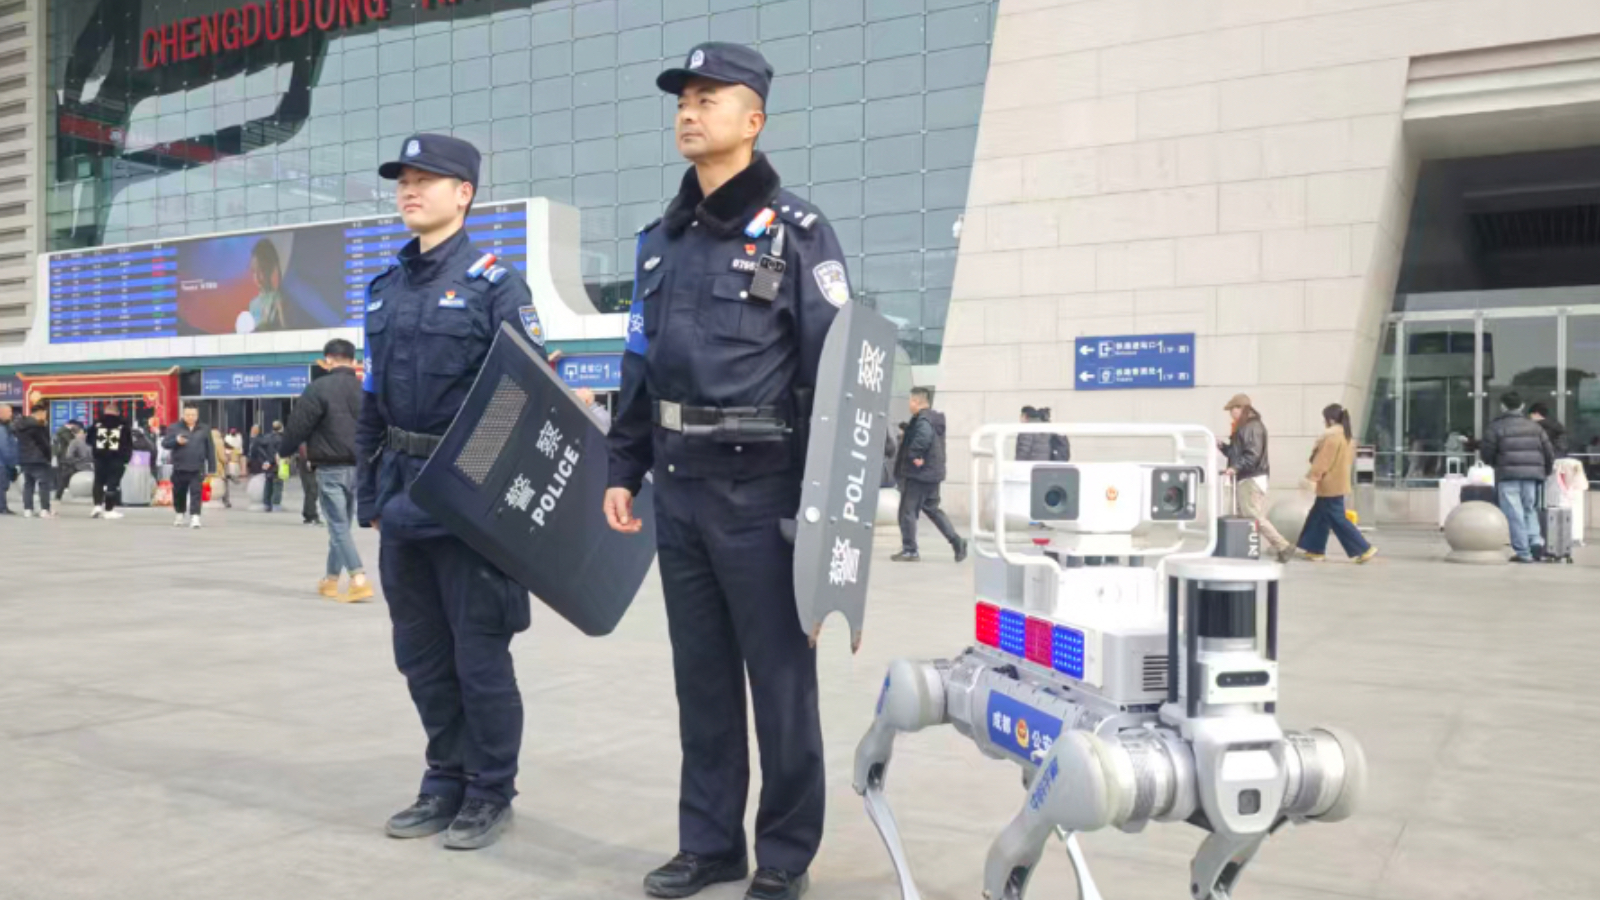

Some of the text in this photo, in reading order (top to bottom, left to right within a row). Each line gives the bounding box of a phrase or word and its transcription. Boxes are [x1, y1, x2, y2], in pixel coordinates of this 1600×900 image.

[141, 0, 386, 68] CHENGDUDONG
[857, 339, 887, 393] 察
[531, 444, 580, 527] POLICE
[843, 407, 873, 523] POLICE
